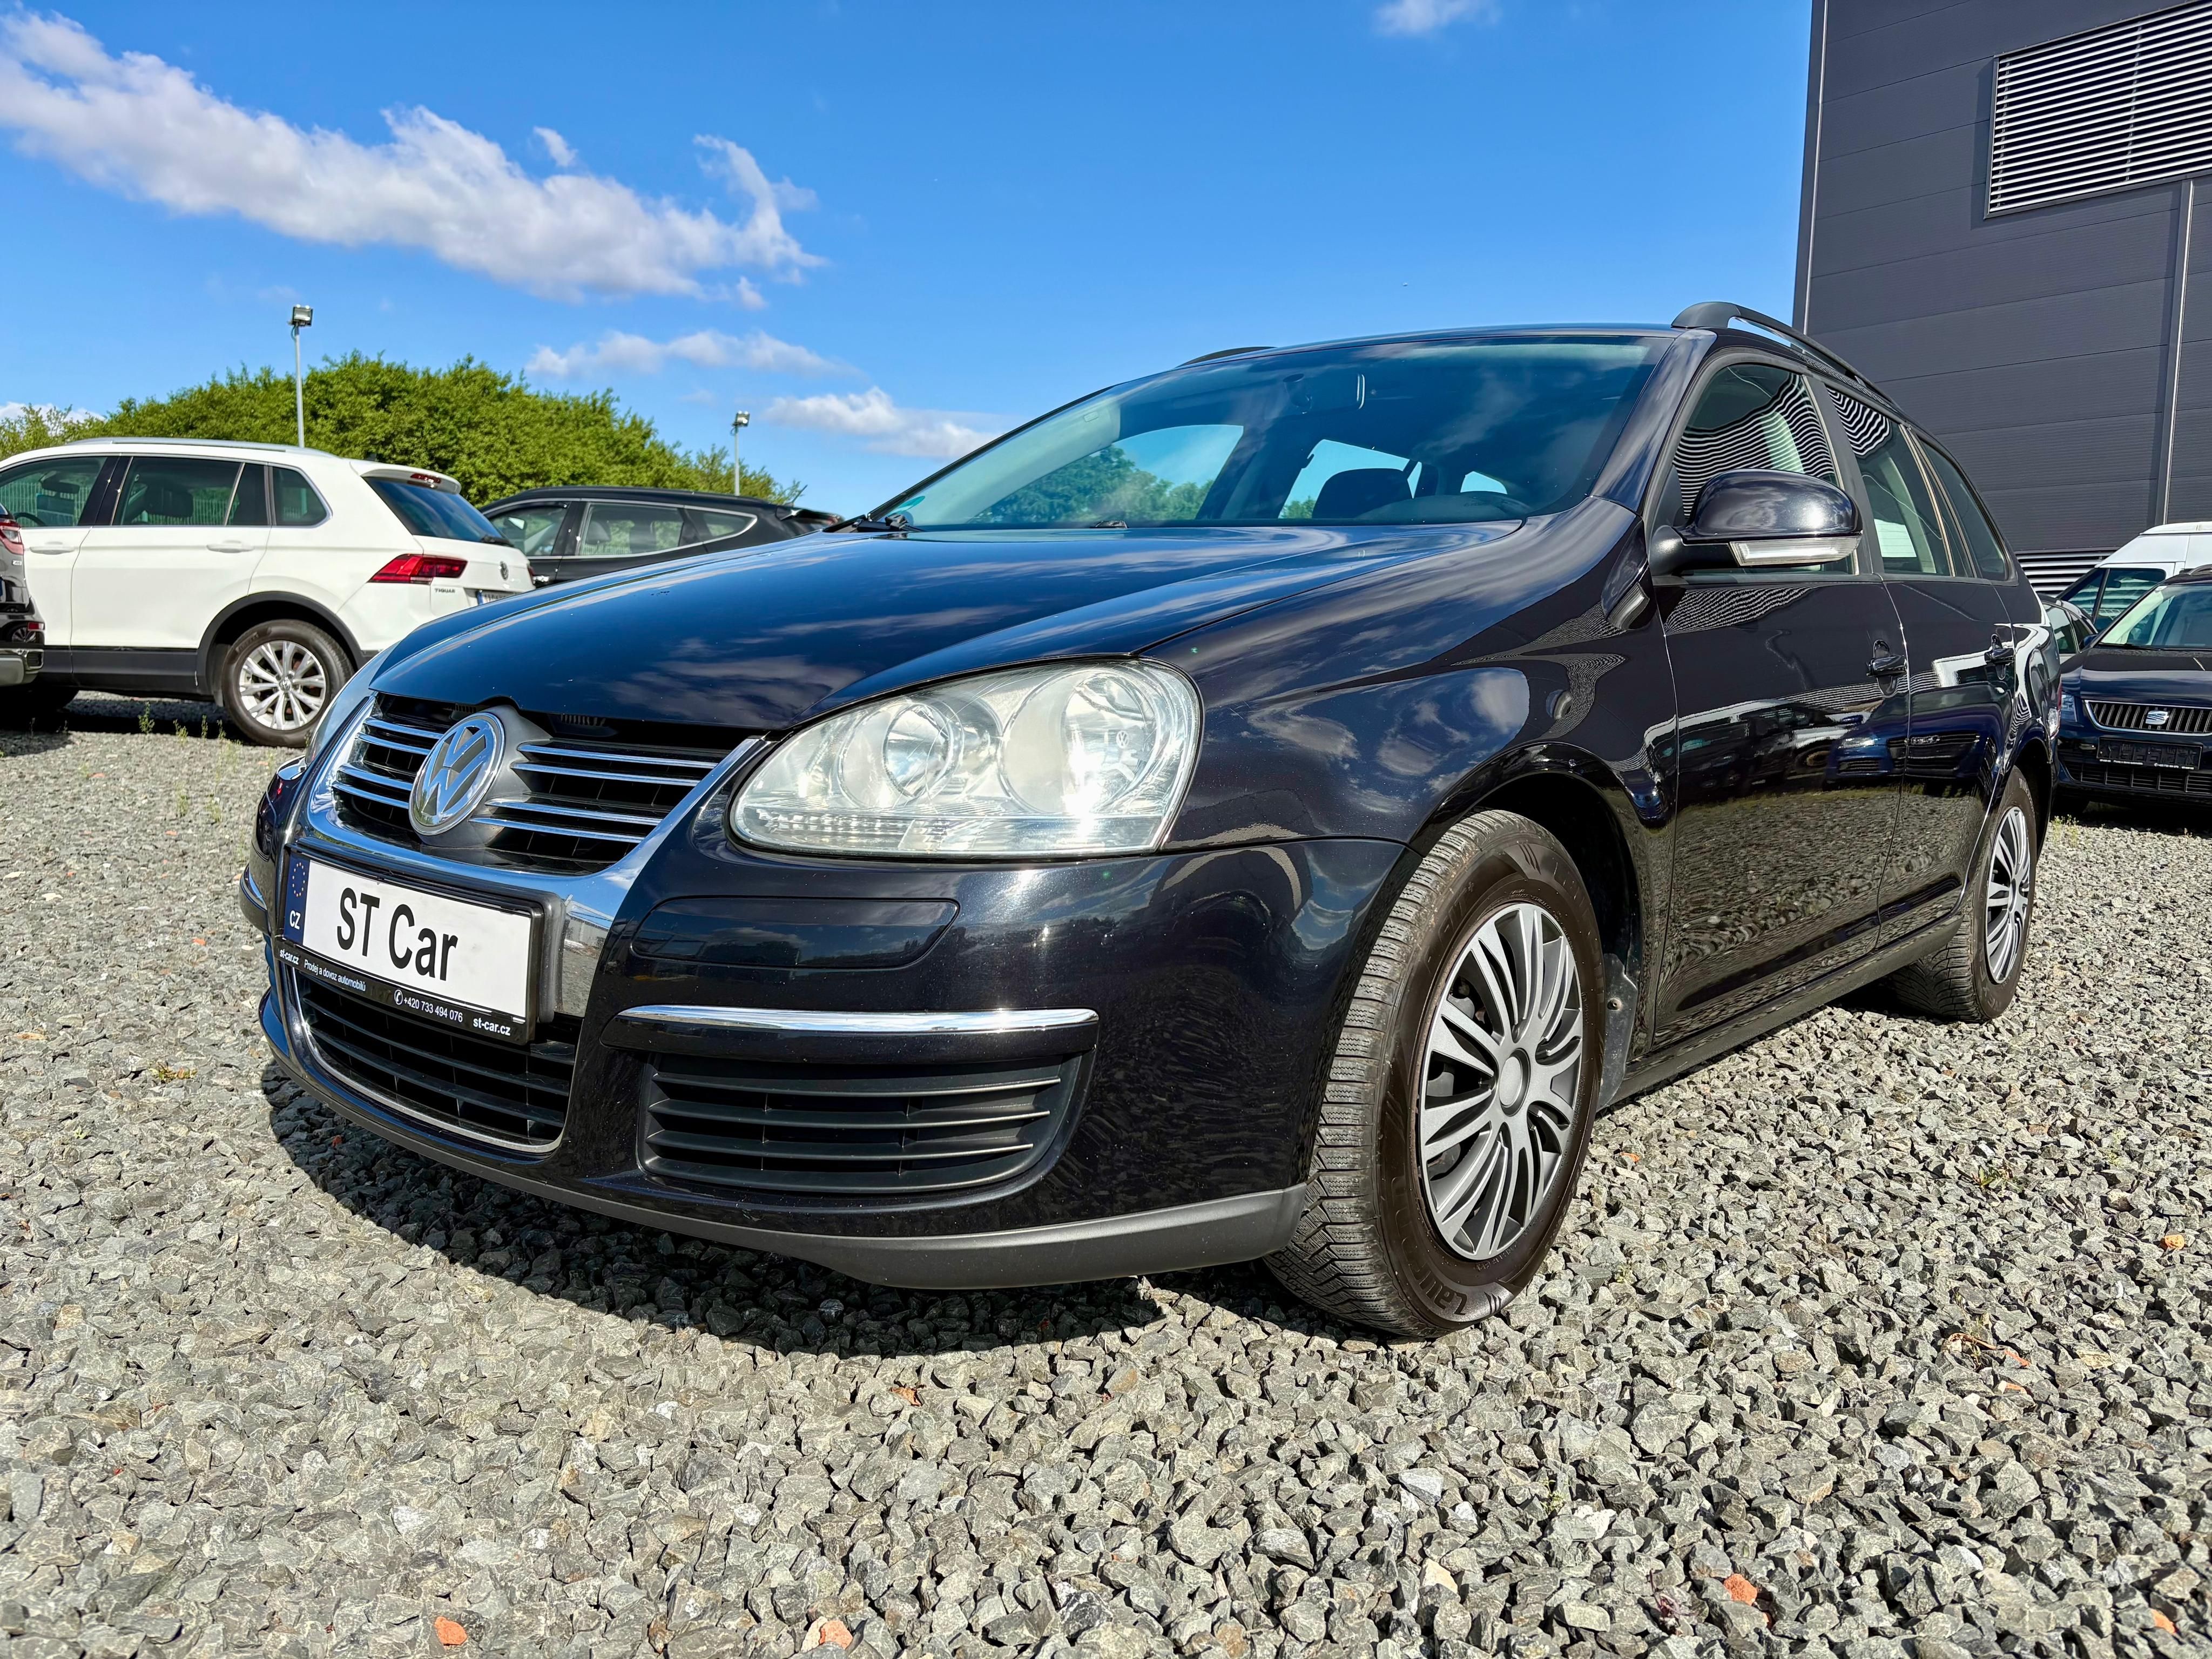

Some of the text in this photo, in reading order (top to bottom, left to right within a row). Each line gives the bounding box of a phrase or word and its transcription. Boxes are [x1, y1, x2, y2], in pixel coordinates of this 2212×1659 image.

[289, 909, 301, 930] CZ
[336, 887, 458, 982] ST Car
[279, 948, 366, 992] st-car.cz Prodej a dovoz automobilů
[403, 997, 463, 1023] +420 733 494 076
[473, 1017, 511, 1036] st-car.cz
